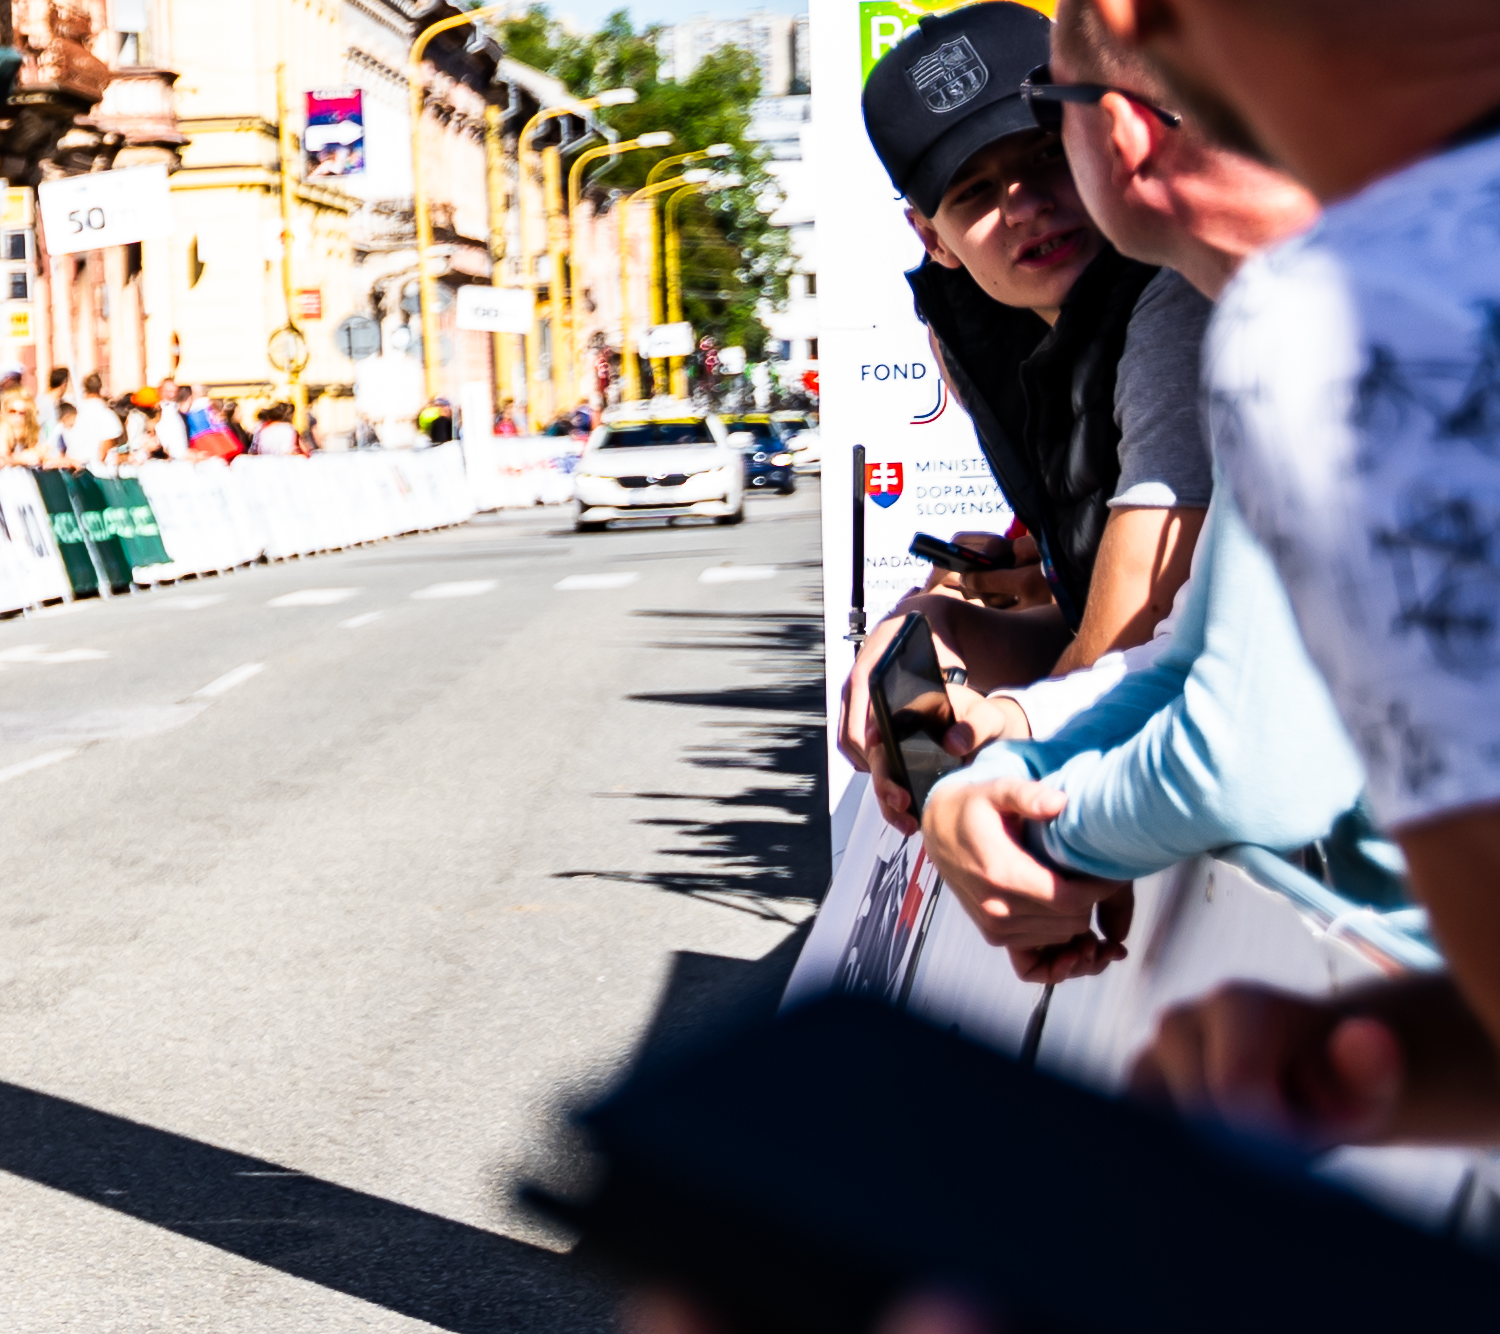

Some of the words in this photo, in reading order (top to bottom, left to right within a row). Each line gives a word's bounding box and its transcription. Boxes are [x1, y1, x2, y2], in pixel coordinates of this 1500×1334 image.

[861, 362, 928, 382] FOND
[915, 457, 990, 472] MINISTE
[916, 500, 1014, 517] SLOVENSK
